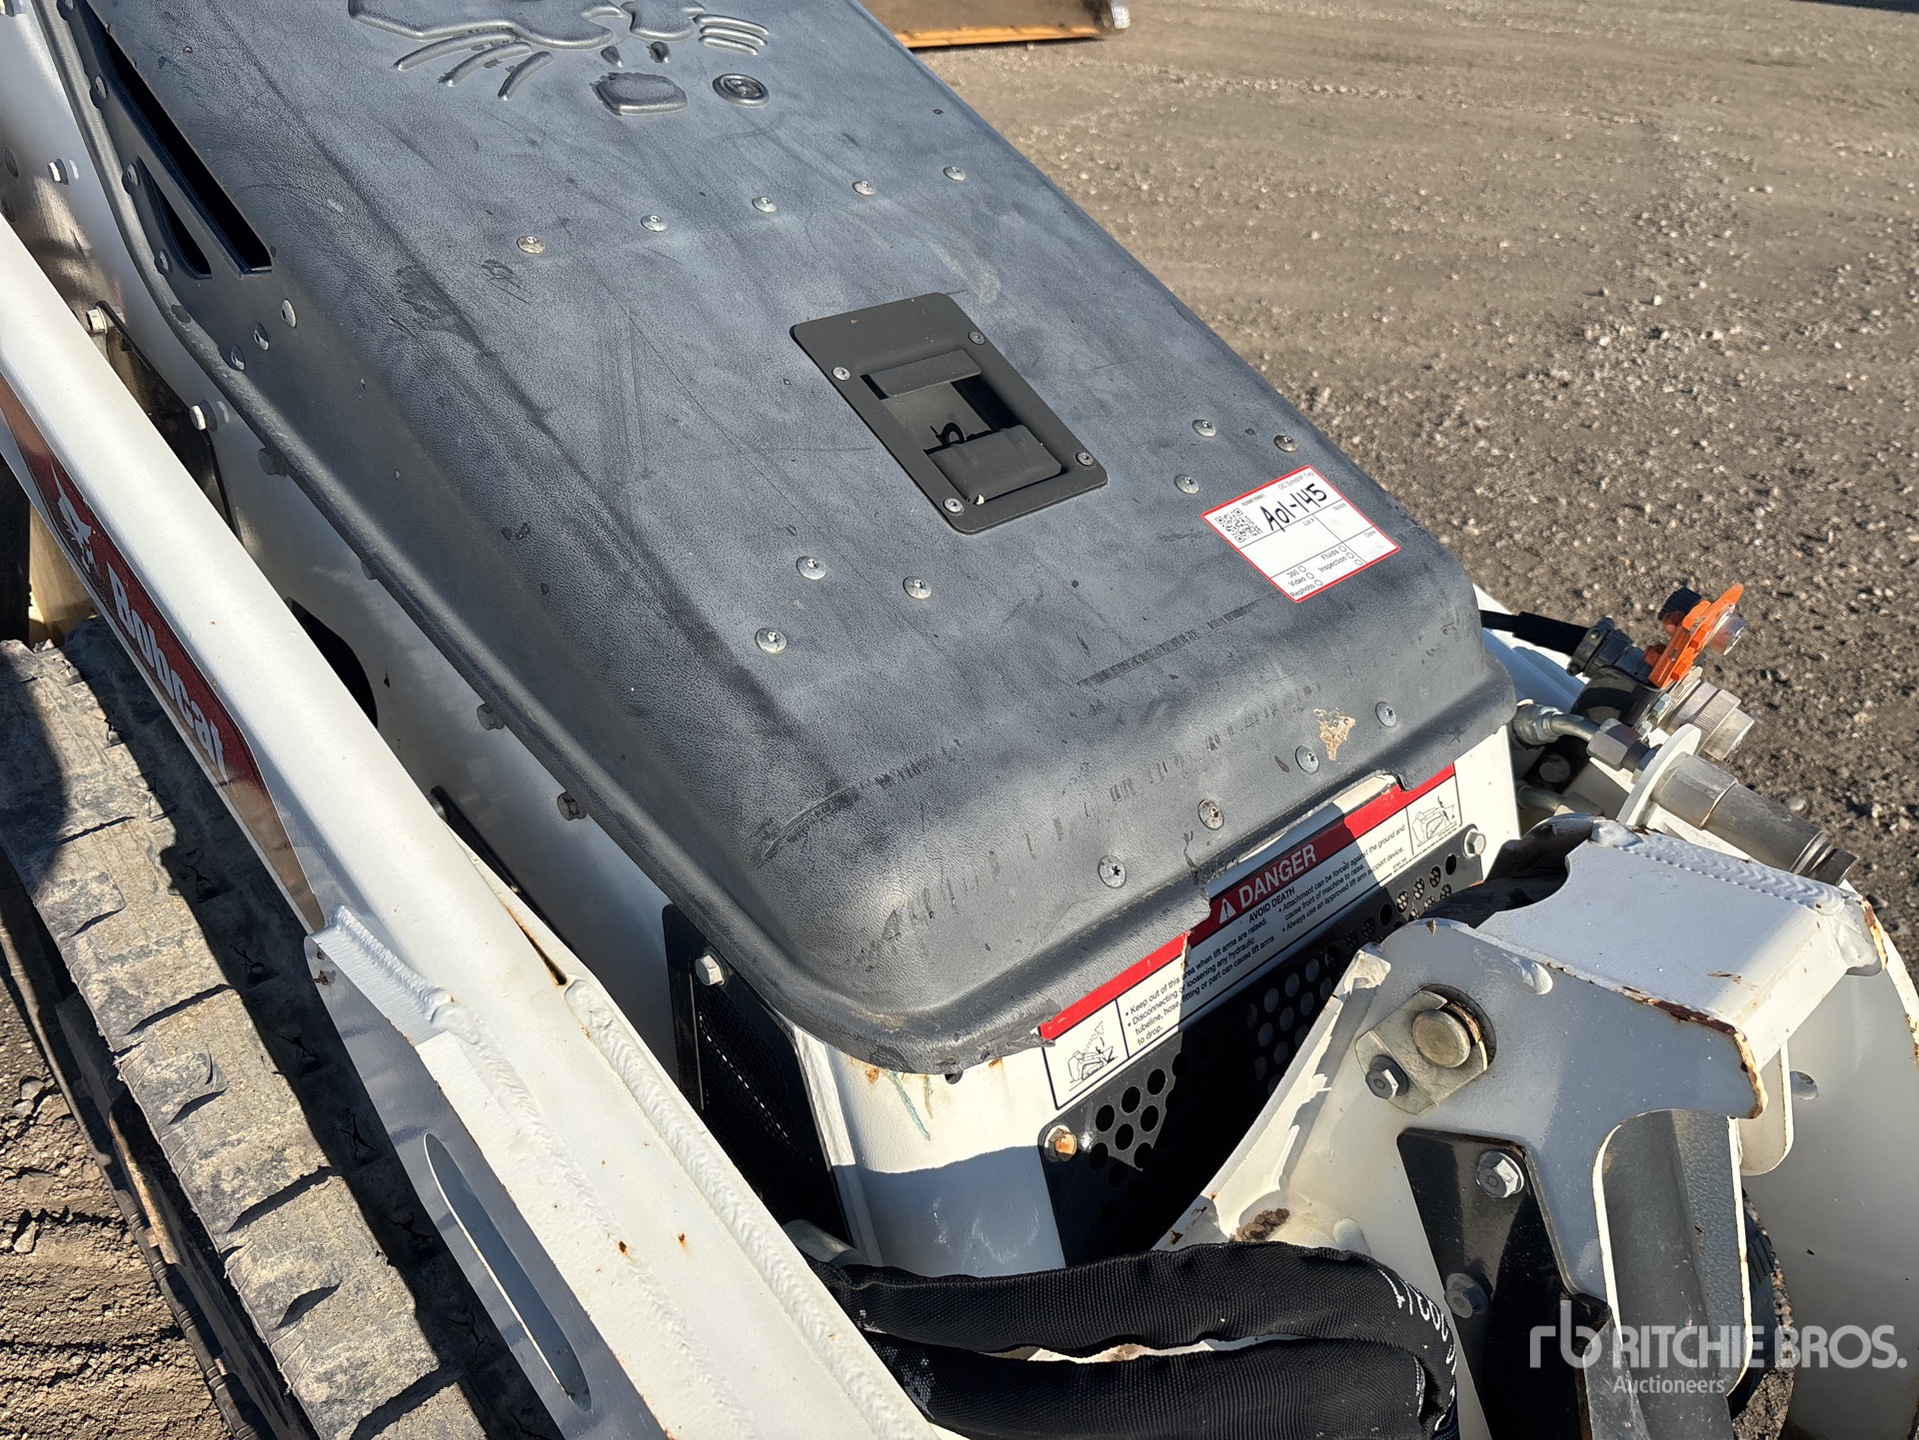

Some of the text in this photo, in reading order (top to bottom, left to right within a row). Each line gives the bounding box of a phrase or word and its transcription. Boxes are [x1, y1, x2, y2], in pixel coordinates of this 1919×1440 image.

[1286, 569, 1300, 578] 360
[1317, 555, 1348, 573] Inspection
[1320, 548, 1340, 560] Fluids
[1287, 576, 1307, 587] Video
[1289, 584, 1316, 598] Rephoto
[107, 560, 229, 784] Bobcat
[1238, 843, 1317, 909] DANGER
[1282, 824, 1405, 912] Attachment can be forced against the ground and
[1286, 913, 1306, 932] Always
[1306, 906, 1317, 917] use
[1317, 901, 1325, 910] an
[1324, 884, 1349, 902] approved
[1349, 878, 1357, 888] lift
[1357, 871, 1367, 882] arm
[1367, 858, 1387, 876] support
[1387, 847, 1405, 863] device.
[1248, 886, 1295, 924] AVOID DEATH
[1284, 904, 1301, 921] cause
[1301, 895, 1316, 910] front
[1316, 890, 1322, 900] of
[1322, 876, 1345, 896] machine
[1344, 872, 1351, 881] to
[1130, 998, 1148, 1015] Keep
[1148, 990, 1161, 1003] out
[1161, 983, 1169, 995] of
[1168, 975, 1181, 990] this
[1181, 967, 1195, 980] area
[1195, 956, 1213, 970] when
[1213, 947, 1222, 959] lift
[1222, 937, 1238, 952] arms
[1238, 930, 1248, 939] are
[1132, 937, 1255, 1025] Disconnecting or loosening any hydraulic
[1135, 1013, 1164, 1035] tubeline,
[1182, 985, 1200, 1003] fitting
[1200, 981, 1208, 990] or
[1208, 970, 1222, 987] part
[1222, 963, 1234, 975] can
[1234, 952, 1251, 968] cause
[1251, 943, 1260, 955] lift
[1260, 935, 1275, 949] arms
[1137, 1024, 1164, 1046] to drop.
